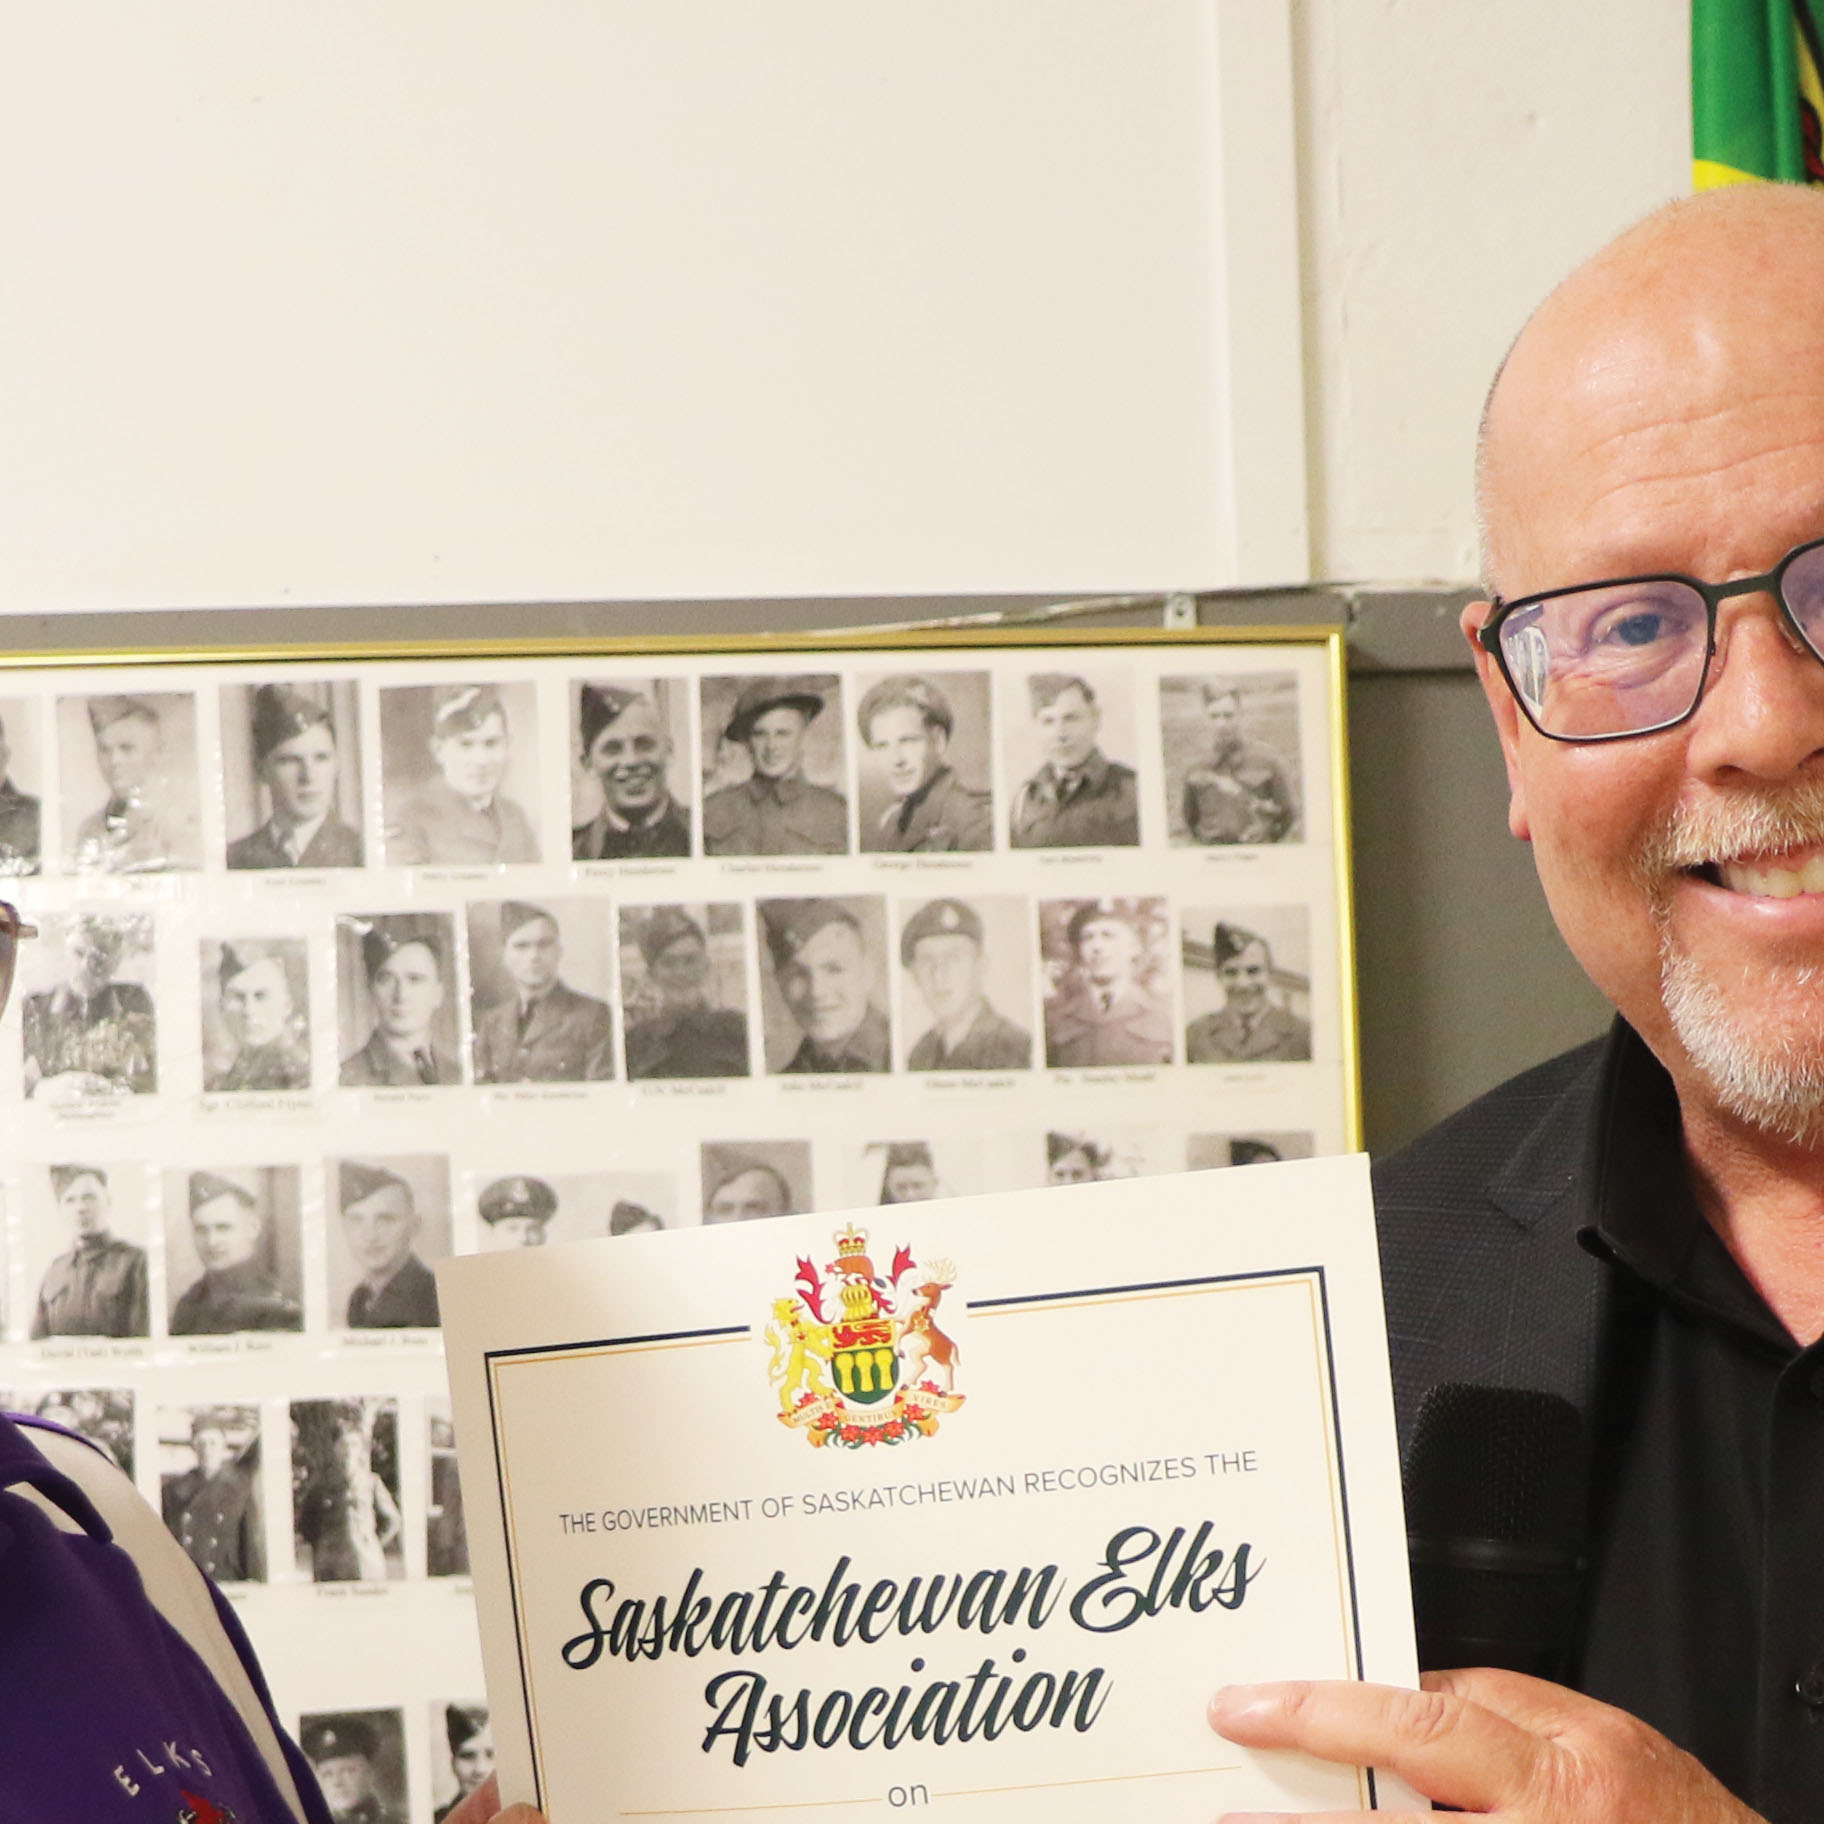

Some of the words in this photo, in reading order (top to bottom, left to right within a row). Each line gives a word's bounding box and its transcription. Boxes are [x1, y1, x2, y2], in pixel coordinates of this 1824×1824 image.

[557, 1511, 597, 1534] THE
[600, 1498, 753, 1532] GOVERNMENT
[760, 1494, 794, 1518] OF
[801, 1474, 1015, 1515] SASKATCHEWAN
[1023, 1455, 1197, 1493] RECOGNIZES
[1203, 1449, 1257, 1475] THE
[560, 1554, 1066, 1671] Saskatchewan
[1067, 1519, 1265, 1634] Elks
[700, 1646, 1113, 1769] Association
[111, 1740, 213, 1797] ELKS
[887, 1783, 928, 1808] on
